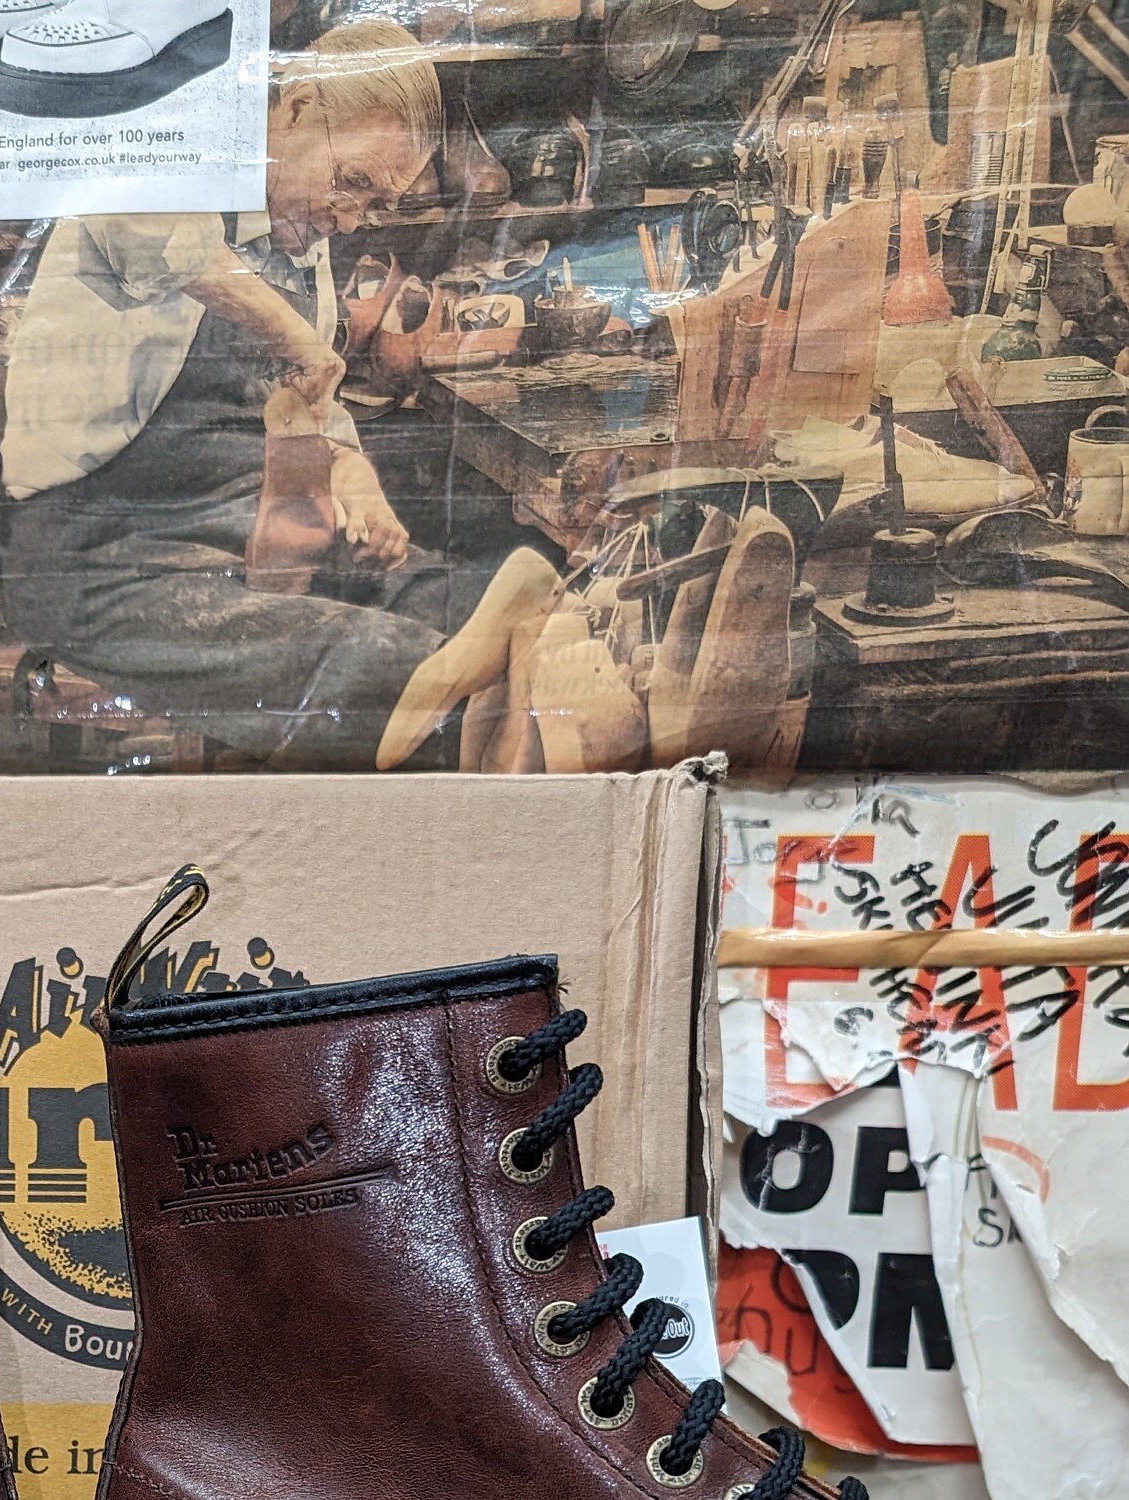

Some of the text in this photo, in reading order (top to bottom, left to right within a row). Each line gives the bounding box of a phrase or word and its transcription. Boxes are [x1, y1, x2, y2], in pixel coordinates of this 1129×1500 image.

[58, 132, 77, 146] for
[82, 133, 113, 146] over
[118, 130, 143, 144] 100
[147, 130, 184, 145] years
[18, 153, 116, 171] georgecox.co.uk
[119, 151, 202, 167] #leadyourway
[166, 1124, 218, 1162] Dr
[176, 1123, 336, 1193] Martens
[180, 1187, 360, 1228] AIR CUSHION SOLES
[1, 1287, 53, 1336] WITH
